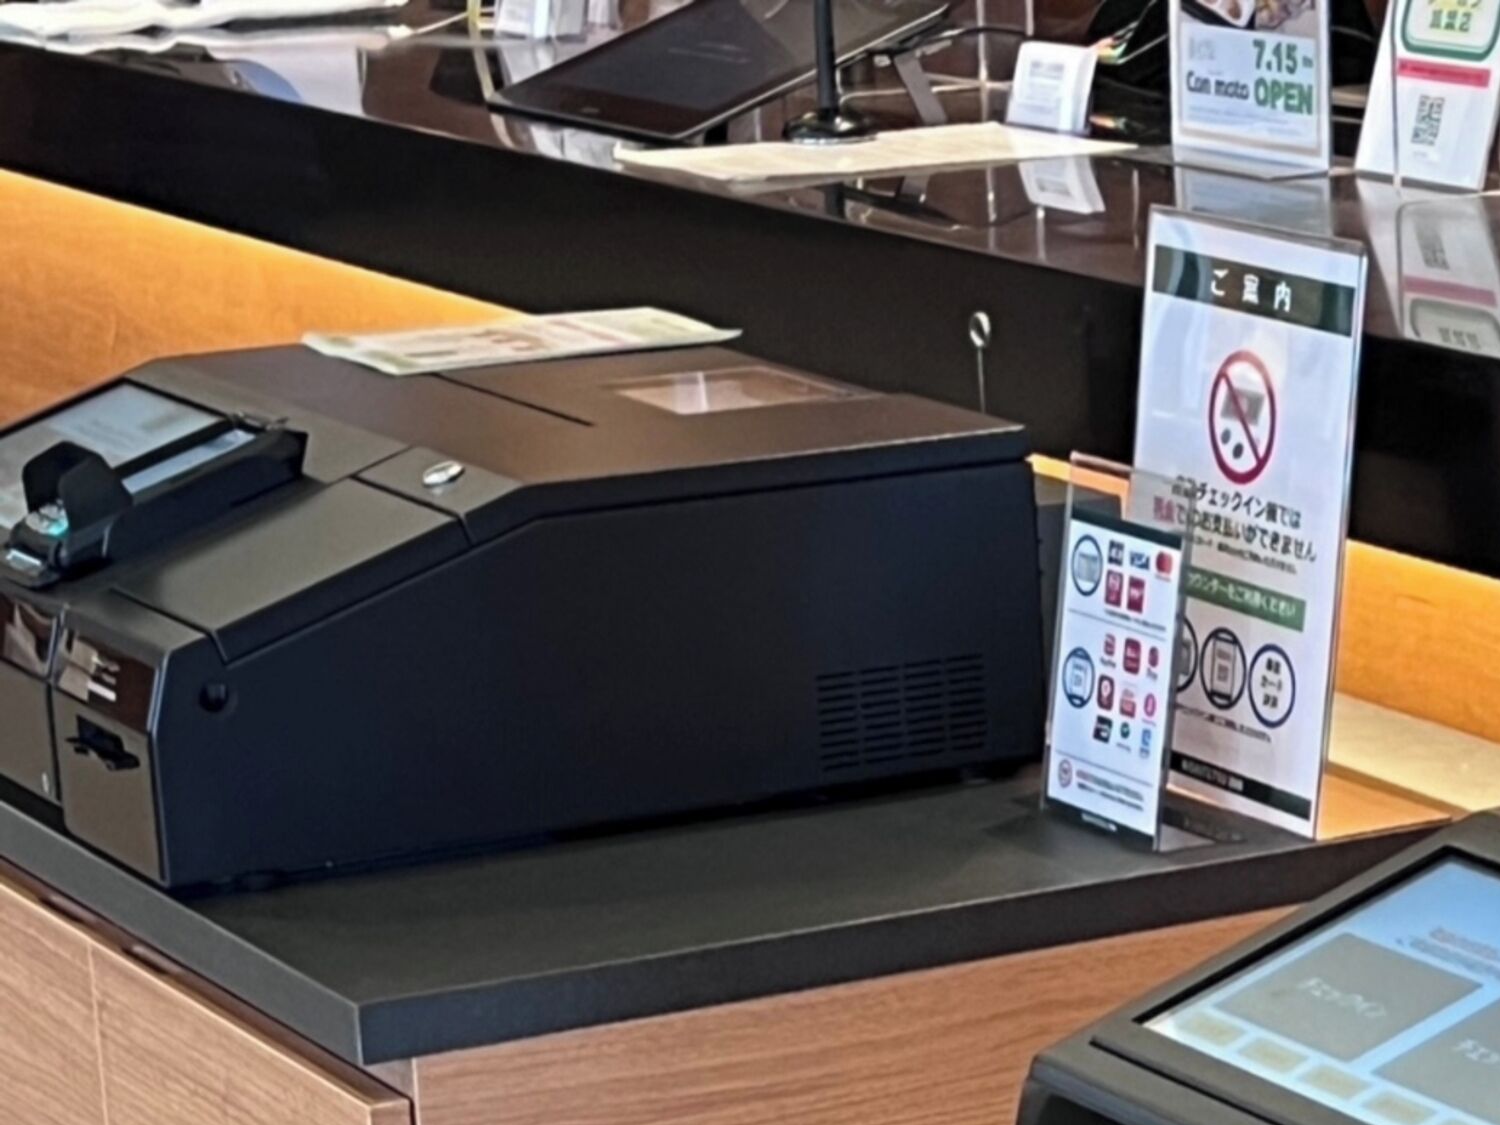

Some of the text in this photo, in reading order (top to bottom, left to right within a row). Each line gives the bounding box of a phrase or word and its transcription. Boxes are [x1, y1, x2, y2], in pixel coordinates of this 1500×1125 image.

[1252, 38, 1298, 75] 7.15
[1253, 77, 1313, 115] OPEN
[1210, 268, 1293, 313] ご案内
